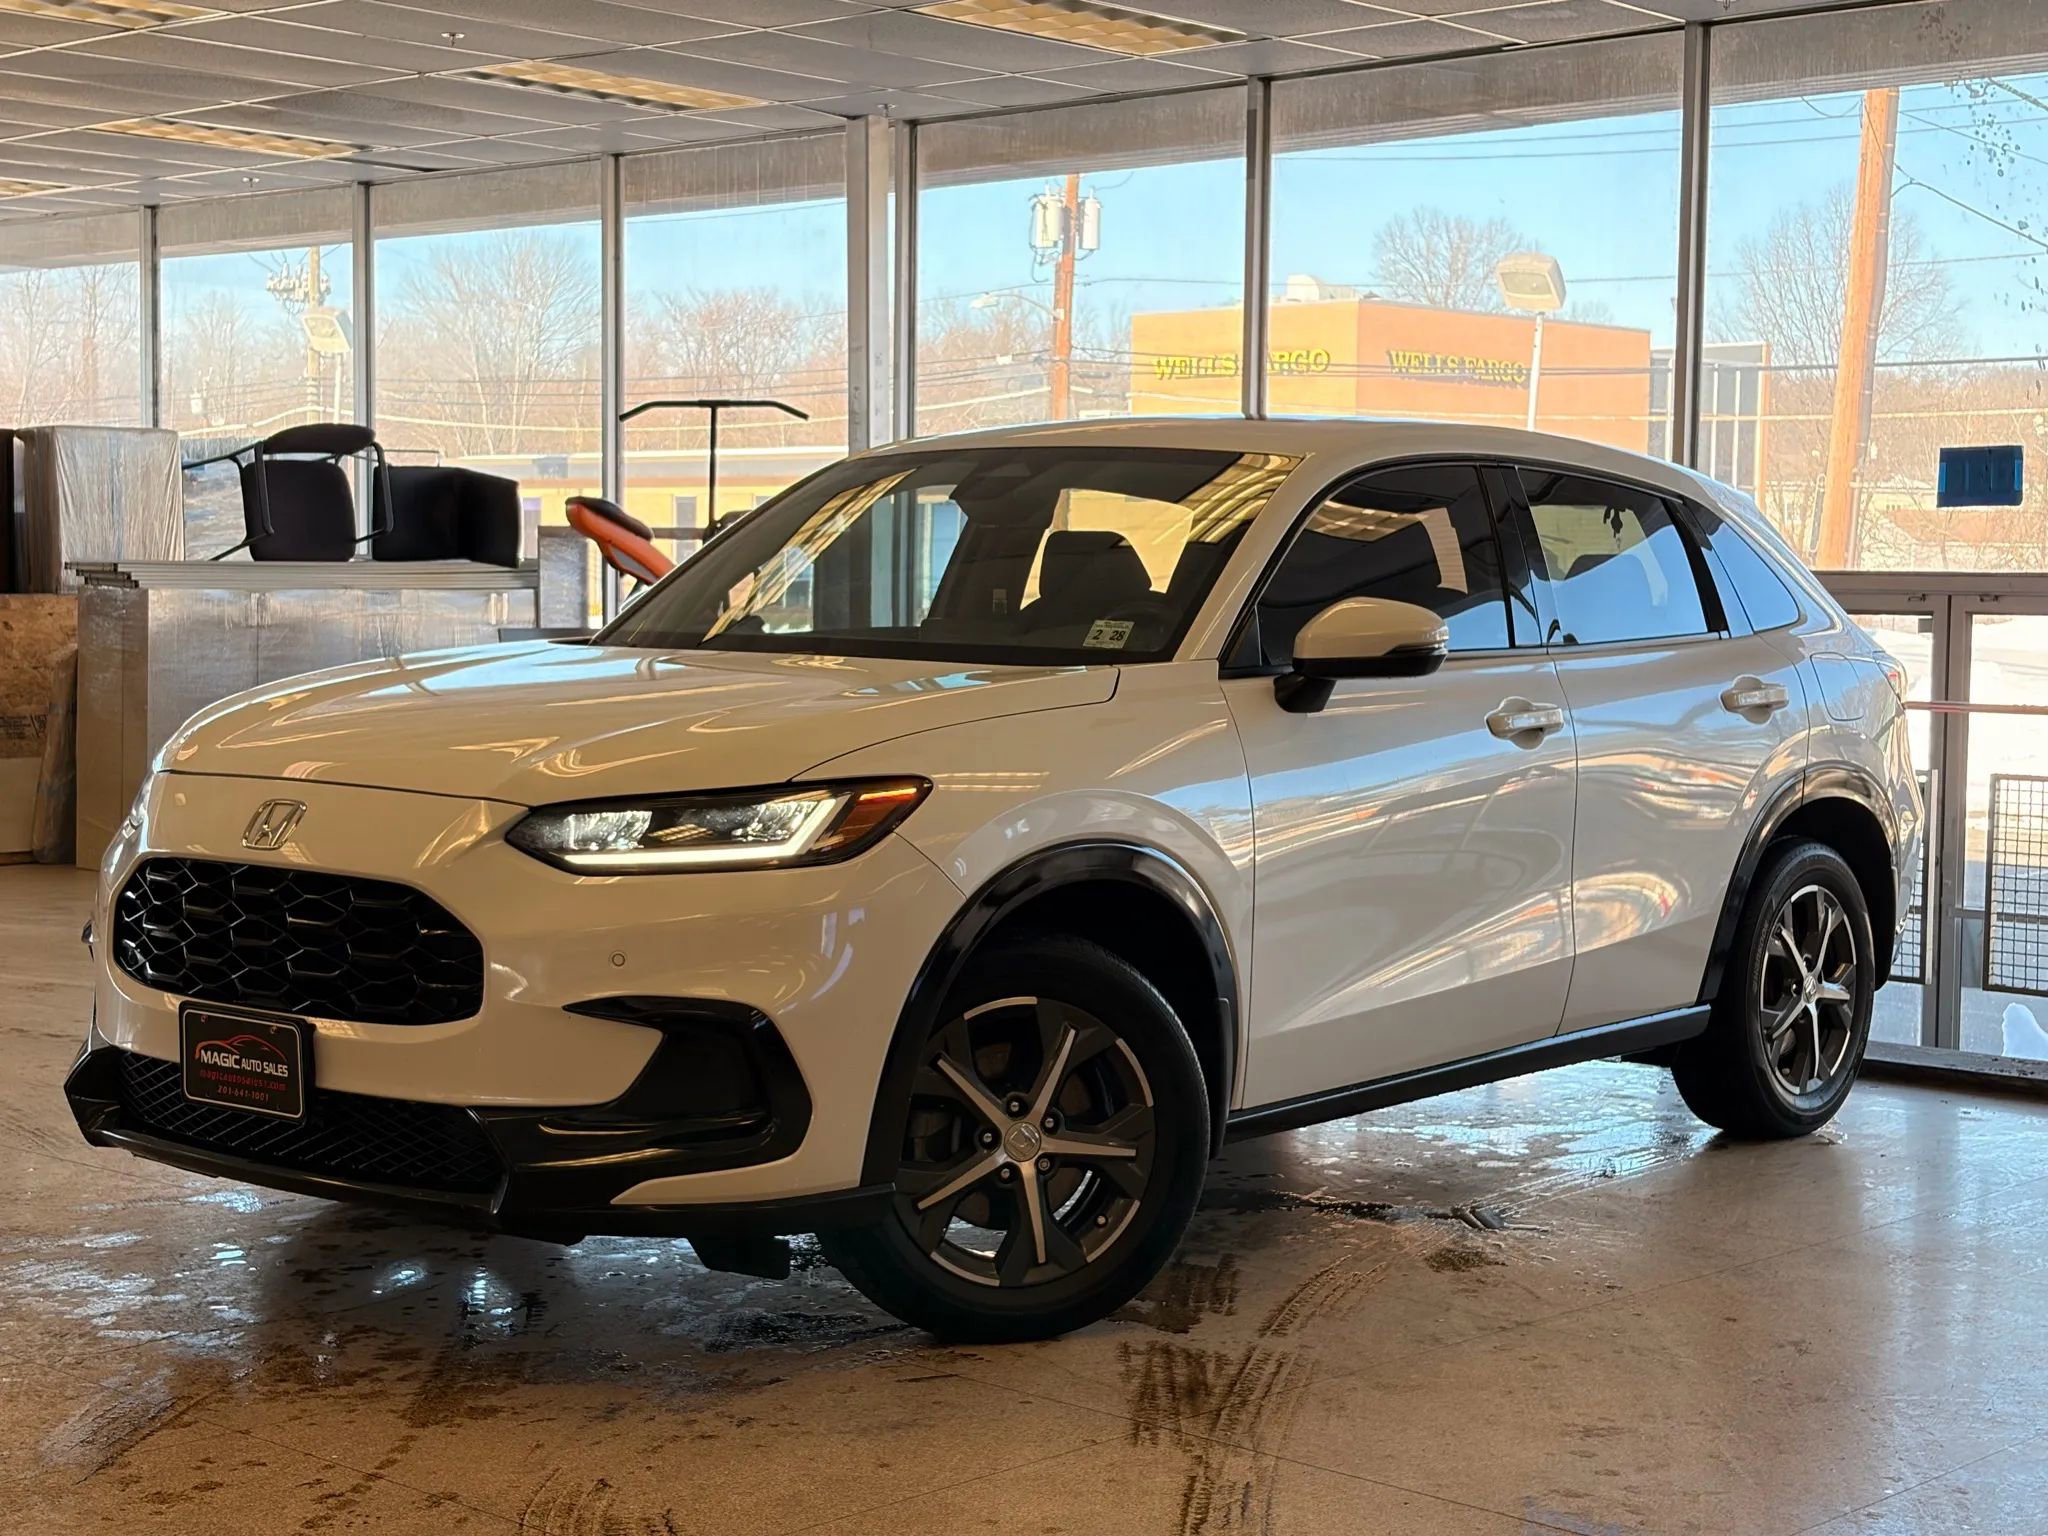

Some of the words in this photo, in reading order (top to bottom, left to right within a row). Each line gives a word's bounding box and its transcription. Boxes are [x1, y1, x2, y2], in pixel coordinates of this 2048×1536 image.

[1153, 353, 1240, 379] WELLS
[1388, 350, 1460, 375] WELLS
[1462, 356, 1528, 385] FARGO
[1092, 629, 1104, 640] 2
[1109, 630, 1126, 641] 28
[200, 1049, 241, 1069] MAGIC
[241, 1058, 262, 1073] AUTO
[263, 1062, 288, 1078] SALES
